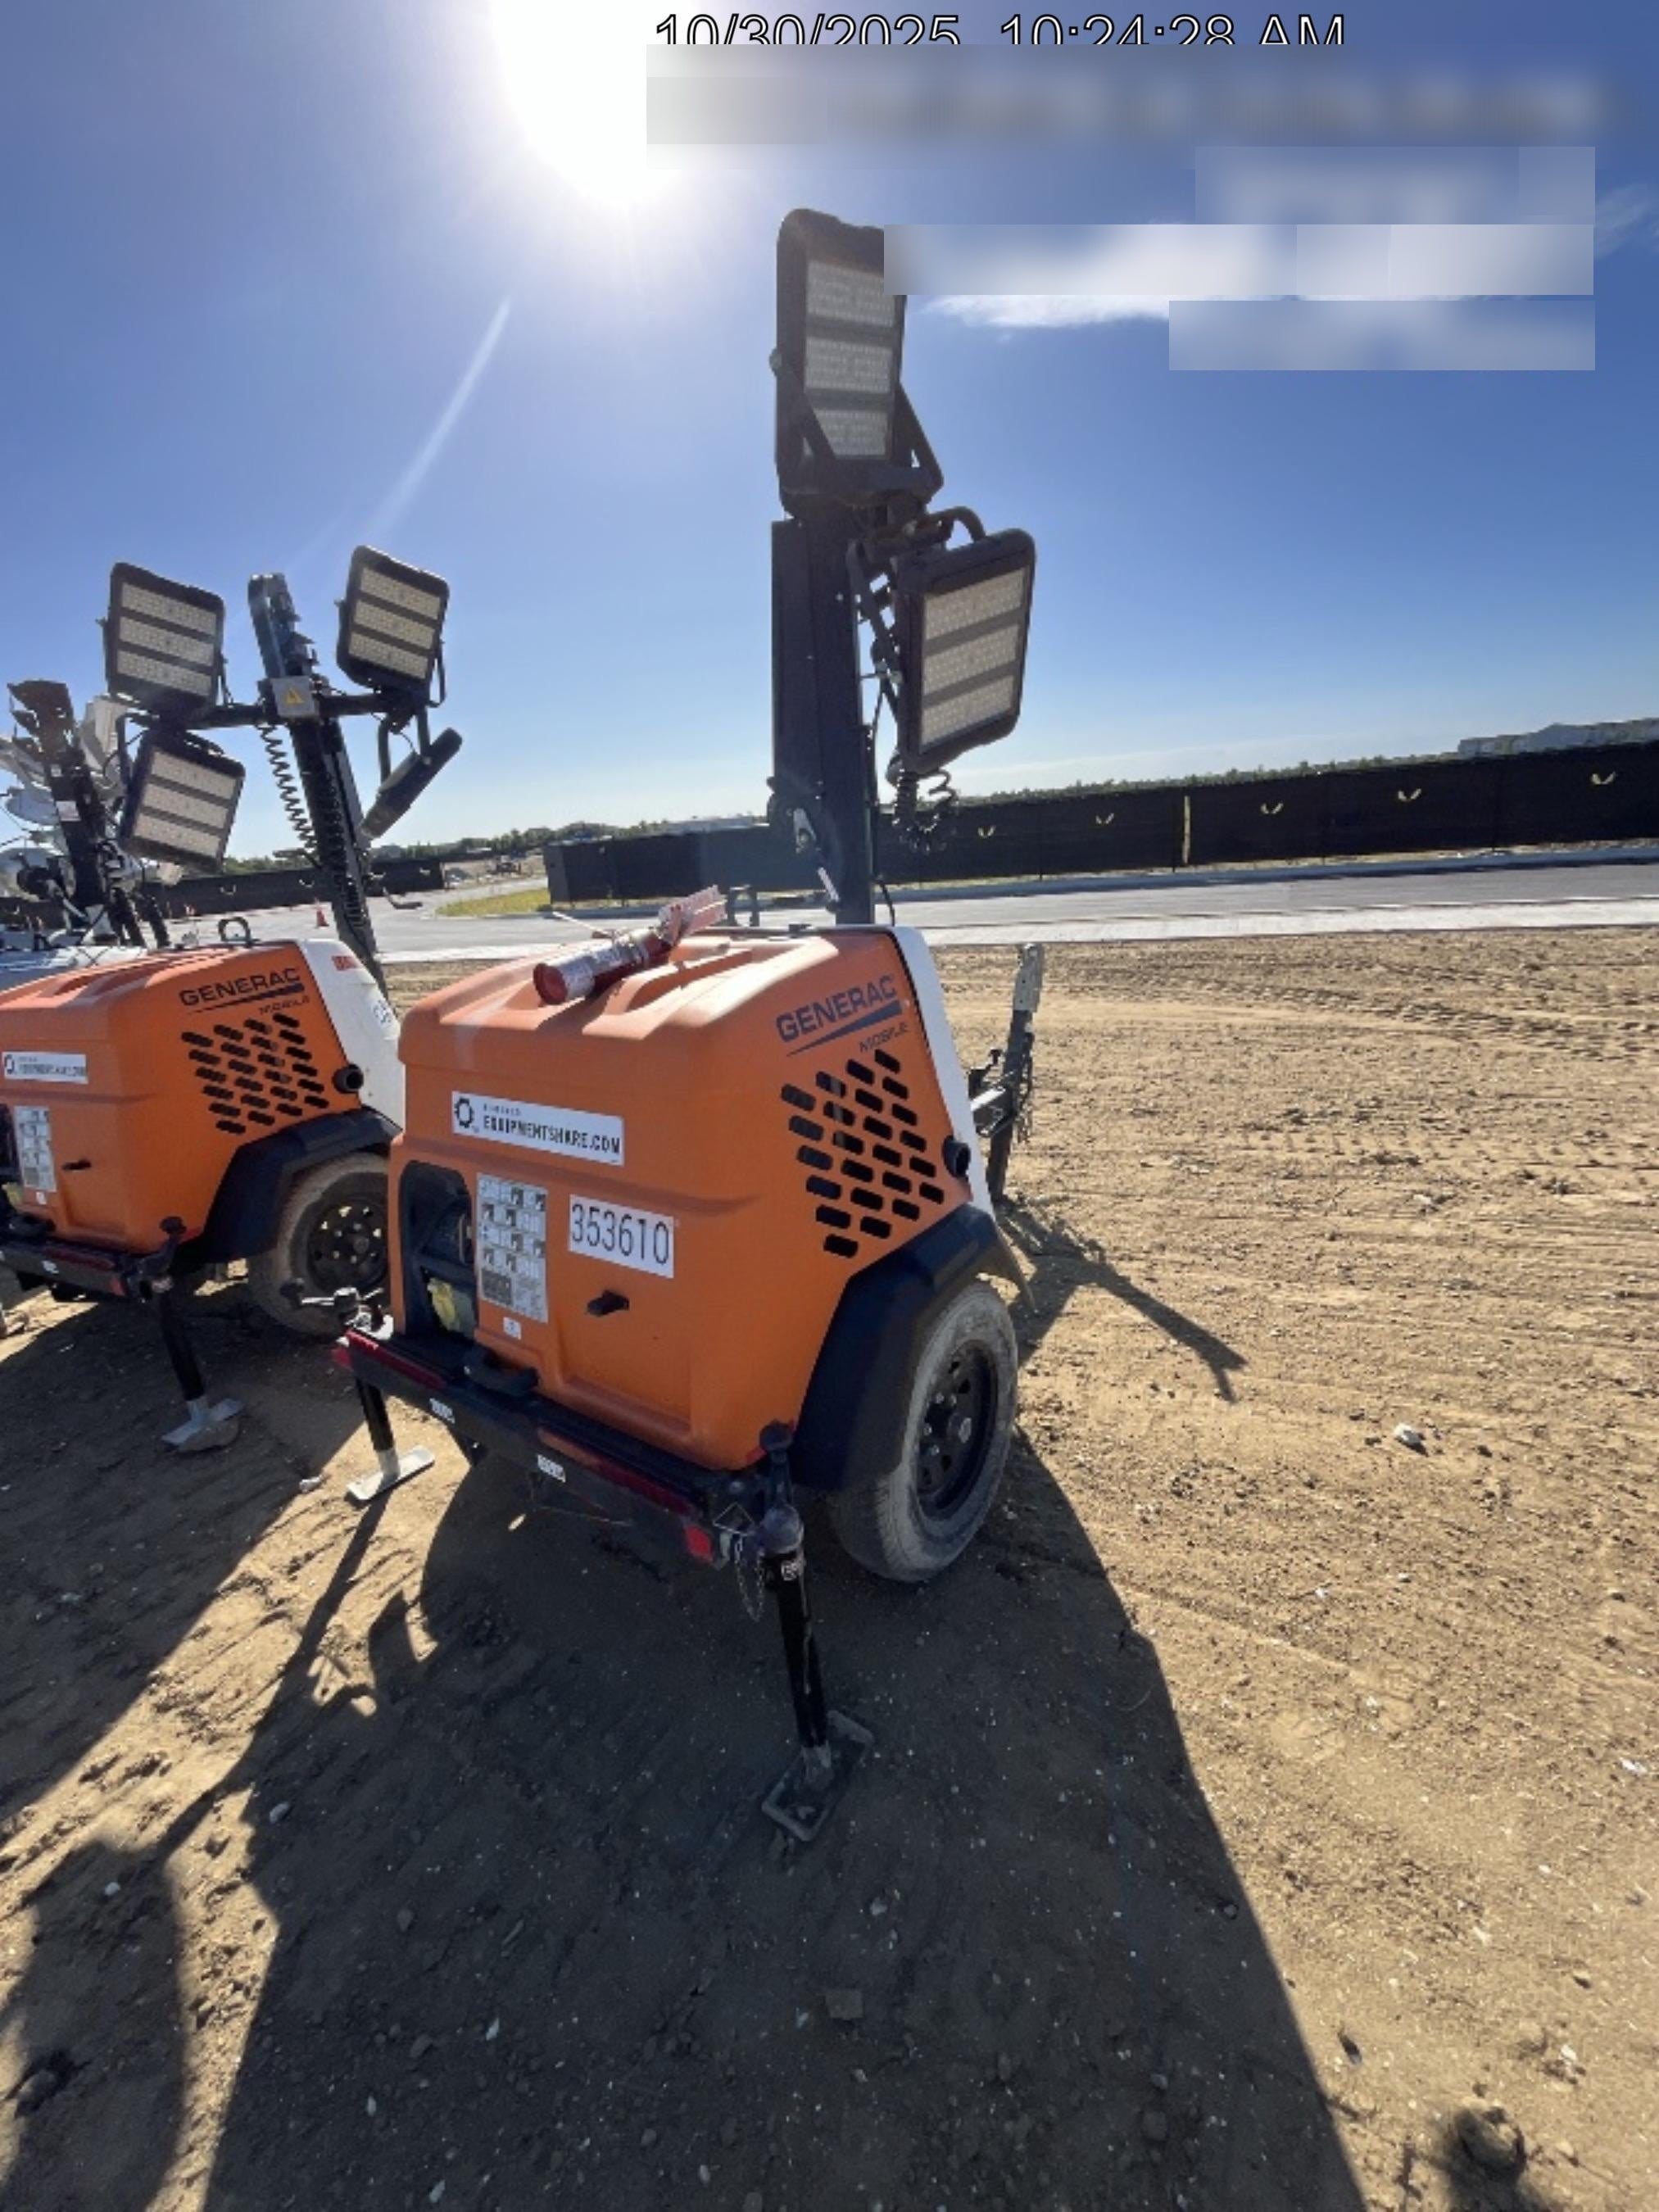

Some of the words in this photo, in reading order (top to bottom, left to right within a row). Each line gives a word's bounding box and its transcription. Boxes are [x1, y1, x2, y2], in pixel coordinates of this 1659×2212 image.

[179, 968, 301, 1006] GENERAC
[776, 975, 897, 1042] GENERAC
[483, 1115, 621, 1154] EQUIPMENTSHARE.COM
[570, 1203, 669, 1265] 353610
